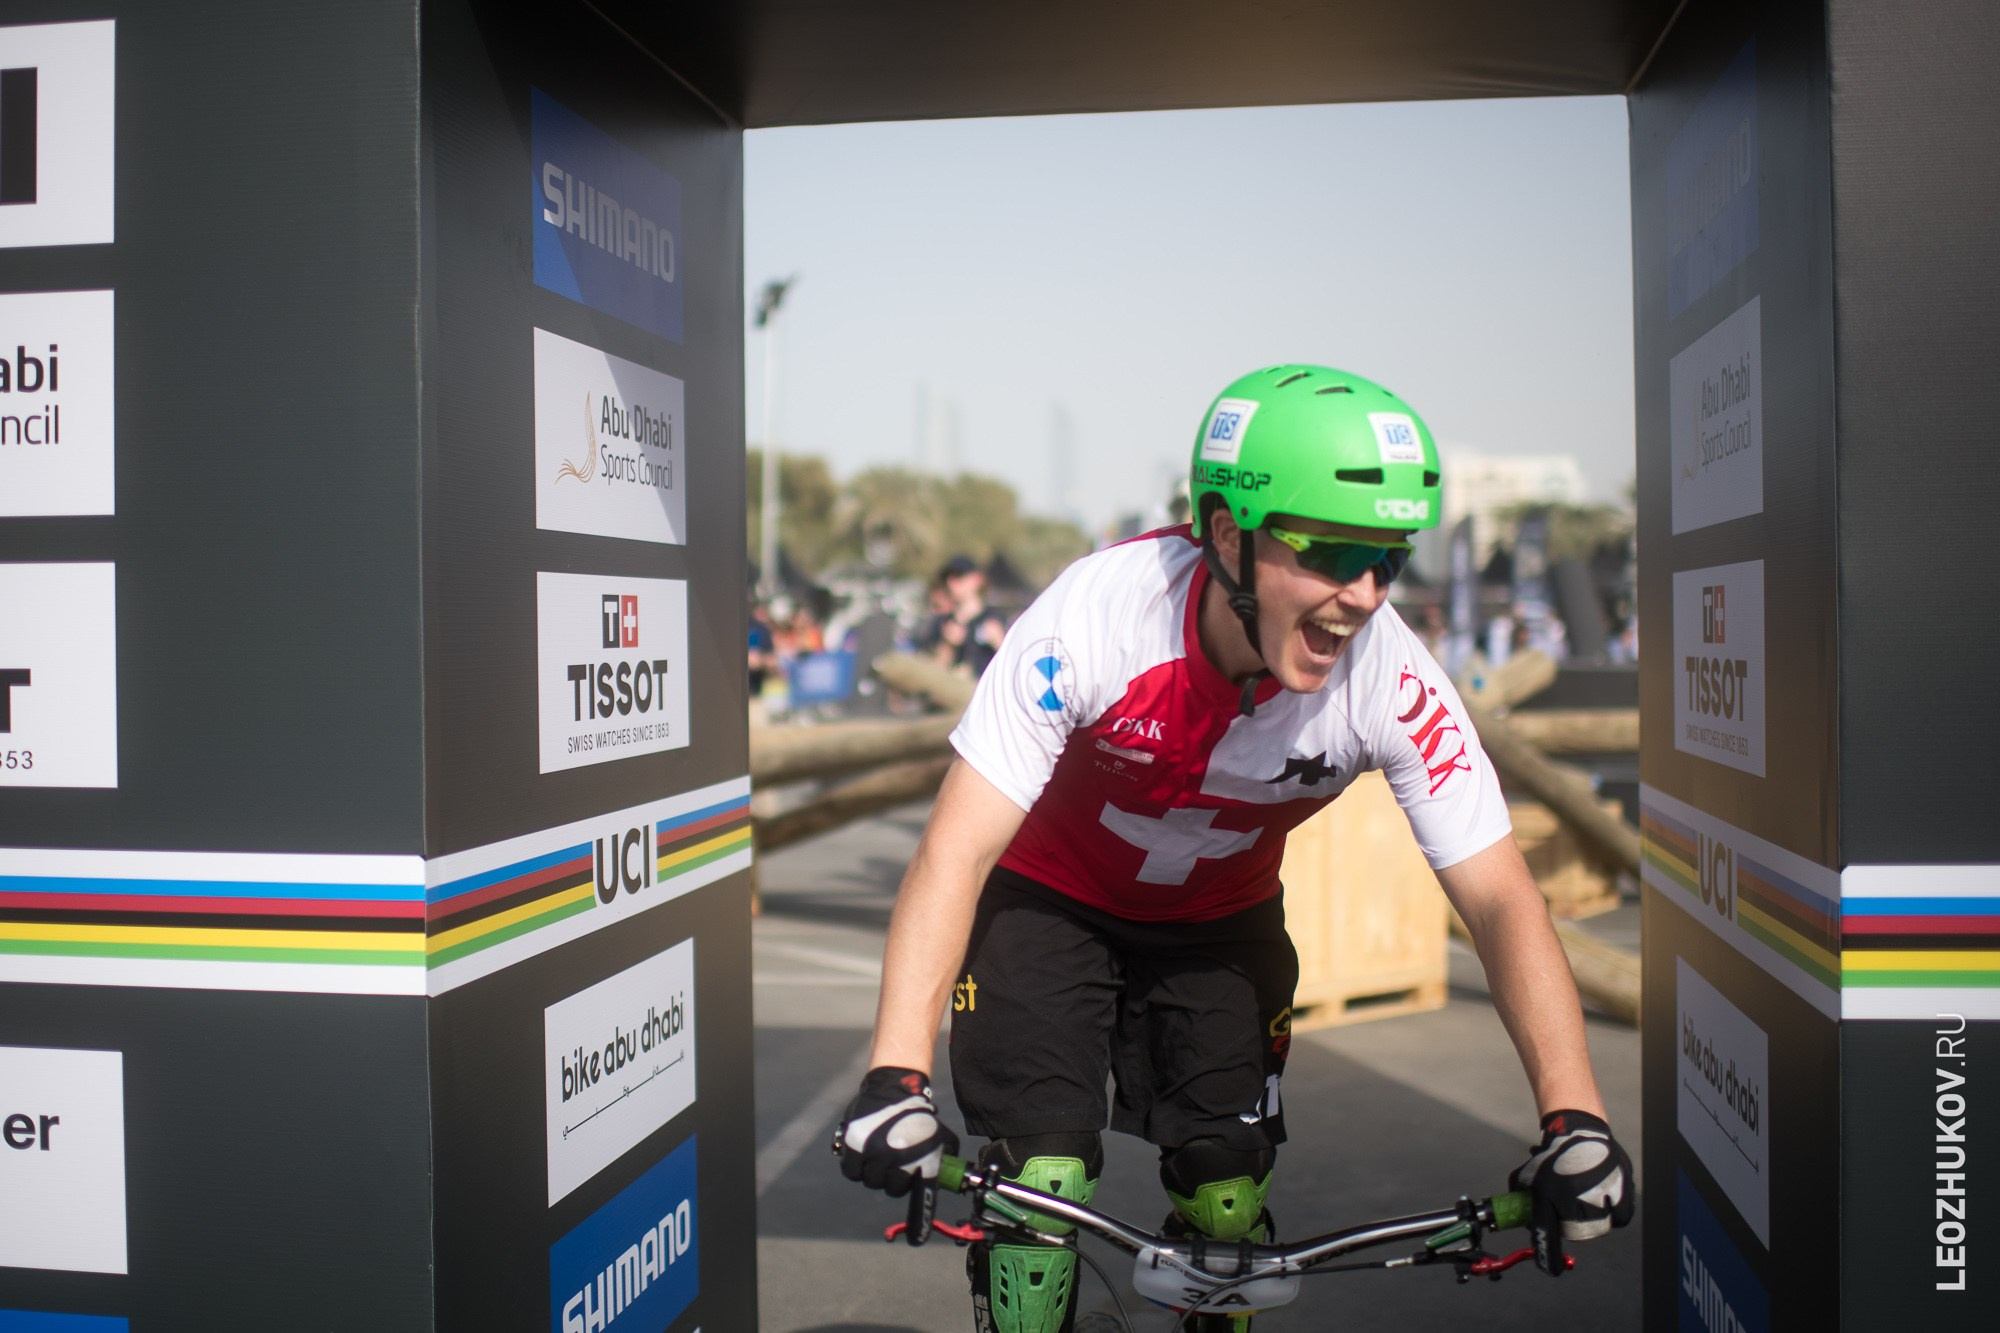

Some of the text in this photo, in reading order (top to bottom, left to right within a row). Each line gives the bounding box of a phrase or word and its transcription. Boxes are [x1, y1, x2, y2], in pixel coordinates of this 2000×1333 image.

[542, 161, 675, 284] SHIMANO
[1701, 351, 1750, 421] Abu Dhabi
[600, 394, 672, 451] Abu Dhabi
[1701, 409, 1752, 473] Sports Council
[600, 443, 673, 490] Sports Council
[567, 659, 668, 722] TISSOT
[1685, 656, 1748, 722] TISSOT
[0, 750, 33, 769] 53
[567, 722, 670, 754] SWISS WATCHES SINCE 1853
[596, 824, 650, 904] UCI
[1699, 832, 1733, 921] UCI
[952, 974, 977, 1012] st
[561, 1045, 601, 1103] bike
[603, 1025, 636, 1076] abu
[641, 990, 683, 1054] dhabi
[1682, 1011, 1759, 1137] bike abu dhabi
[3, 1113, 60, 1151] er
[562, 1199, 691, 1333] SHIMANO
